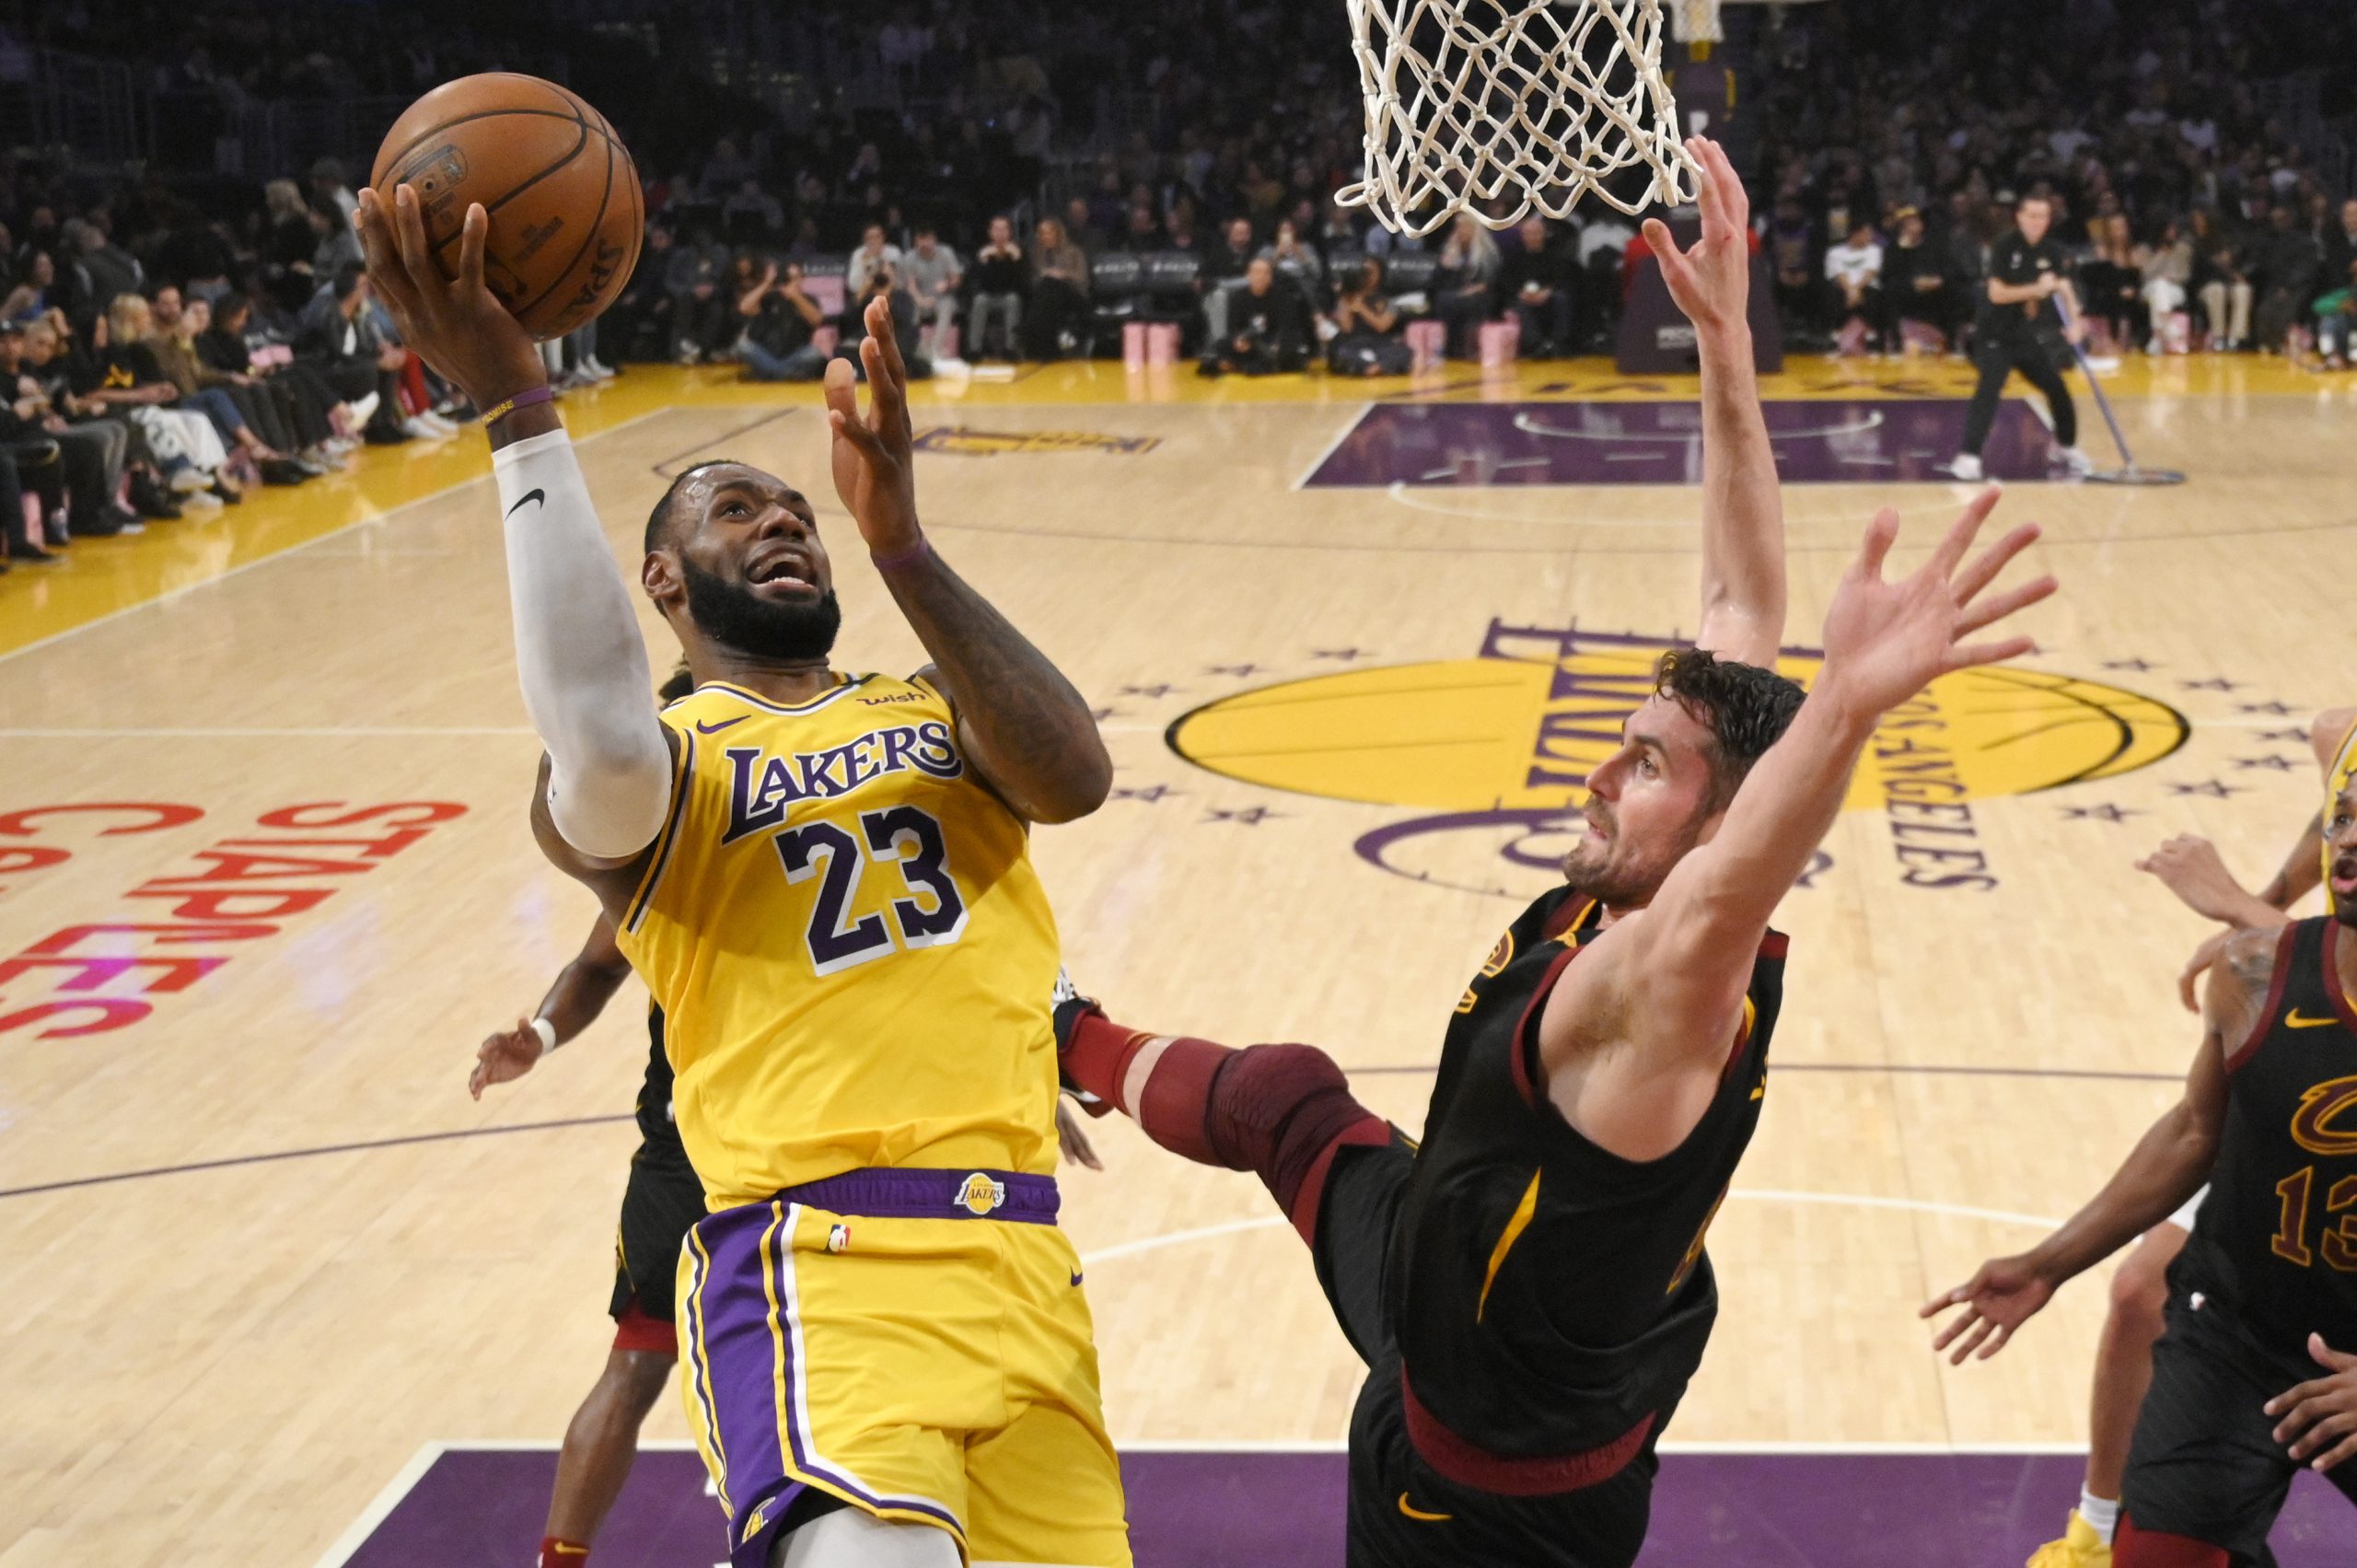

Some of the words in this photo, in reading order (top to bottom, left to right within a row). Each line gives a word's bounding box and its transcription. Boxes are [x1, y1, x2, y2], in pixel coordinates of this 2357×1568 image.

[855, 691, 926, 706] wish
[722, 723, 963, 845] LAKERS
[1873, 733, 1999, 891] ANGELES
[773, 806, 970, 977] 23
[958, 1184, 1004, 1206] LAKERS
[2271, 1165, 2357, 1272] 13
